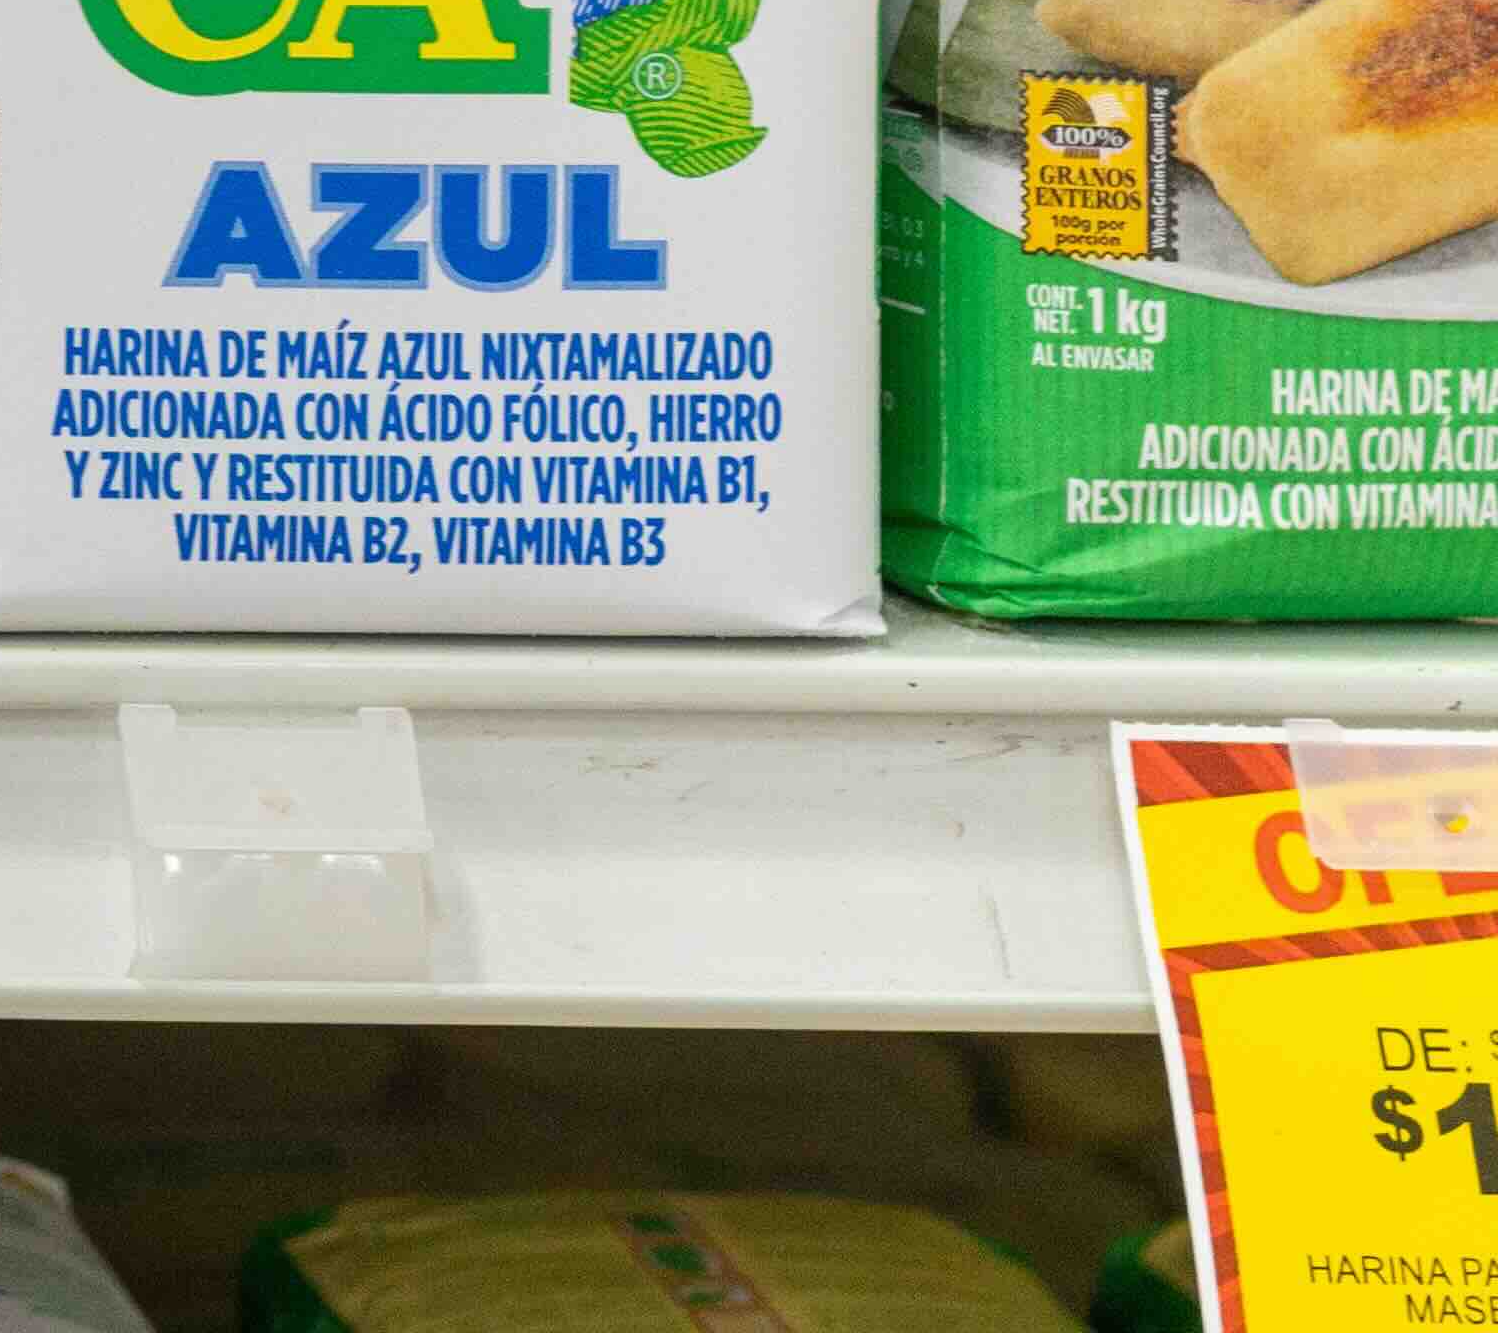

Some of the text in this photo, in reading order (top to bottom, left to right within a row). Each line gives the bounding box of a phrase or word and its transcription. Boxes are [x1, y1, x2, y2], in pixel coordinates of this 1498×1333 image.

[160, 160, 668, 294] AZUL
[1088, 286, 1168, 343] 1 kg
[1139, 422, 1423, 474] ADICIONADA CON
[1066, 477, 1264, 527] RESTITUIDA
[1270, 481, 1340, 529] CON
[1377, 1026, 1473, 1073] DE:
[1306, 1254, 1452, 1286] HARINA
